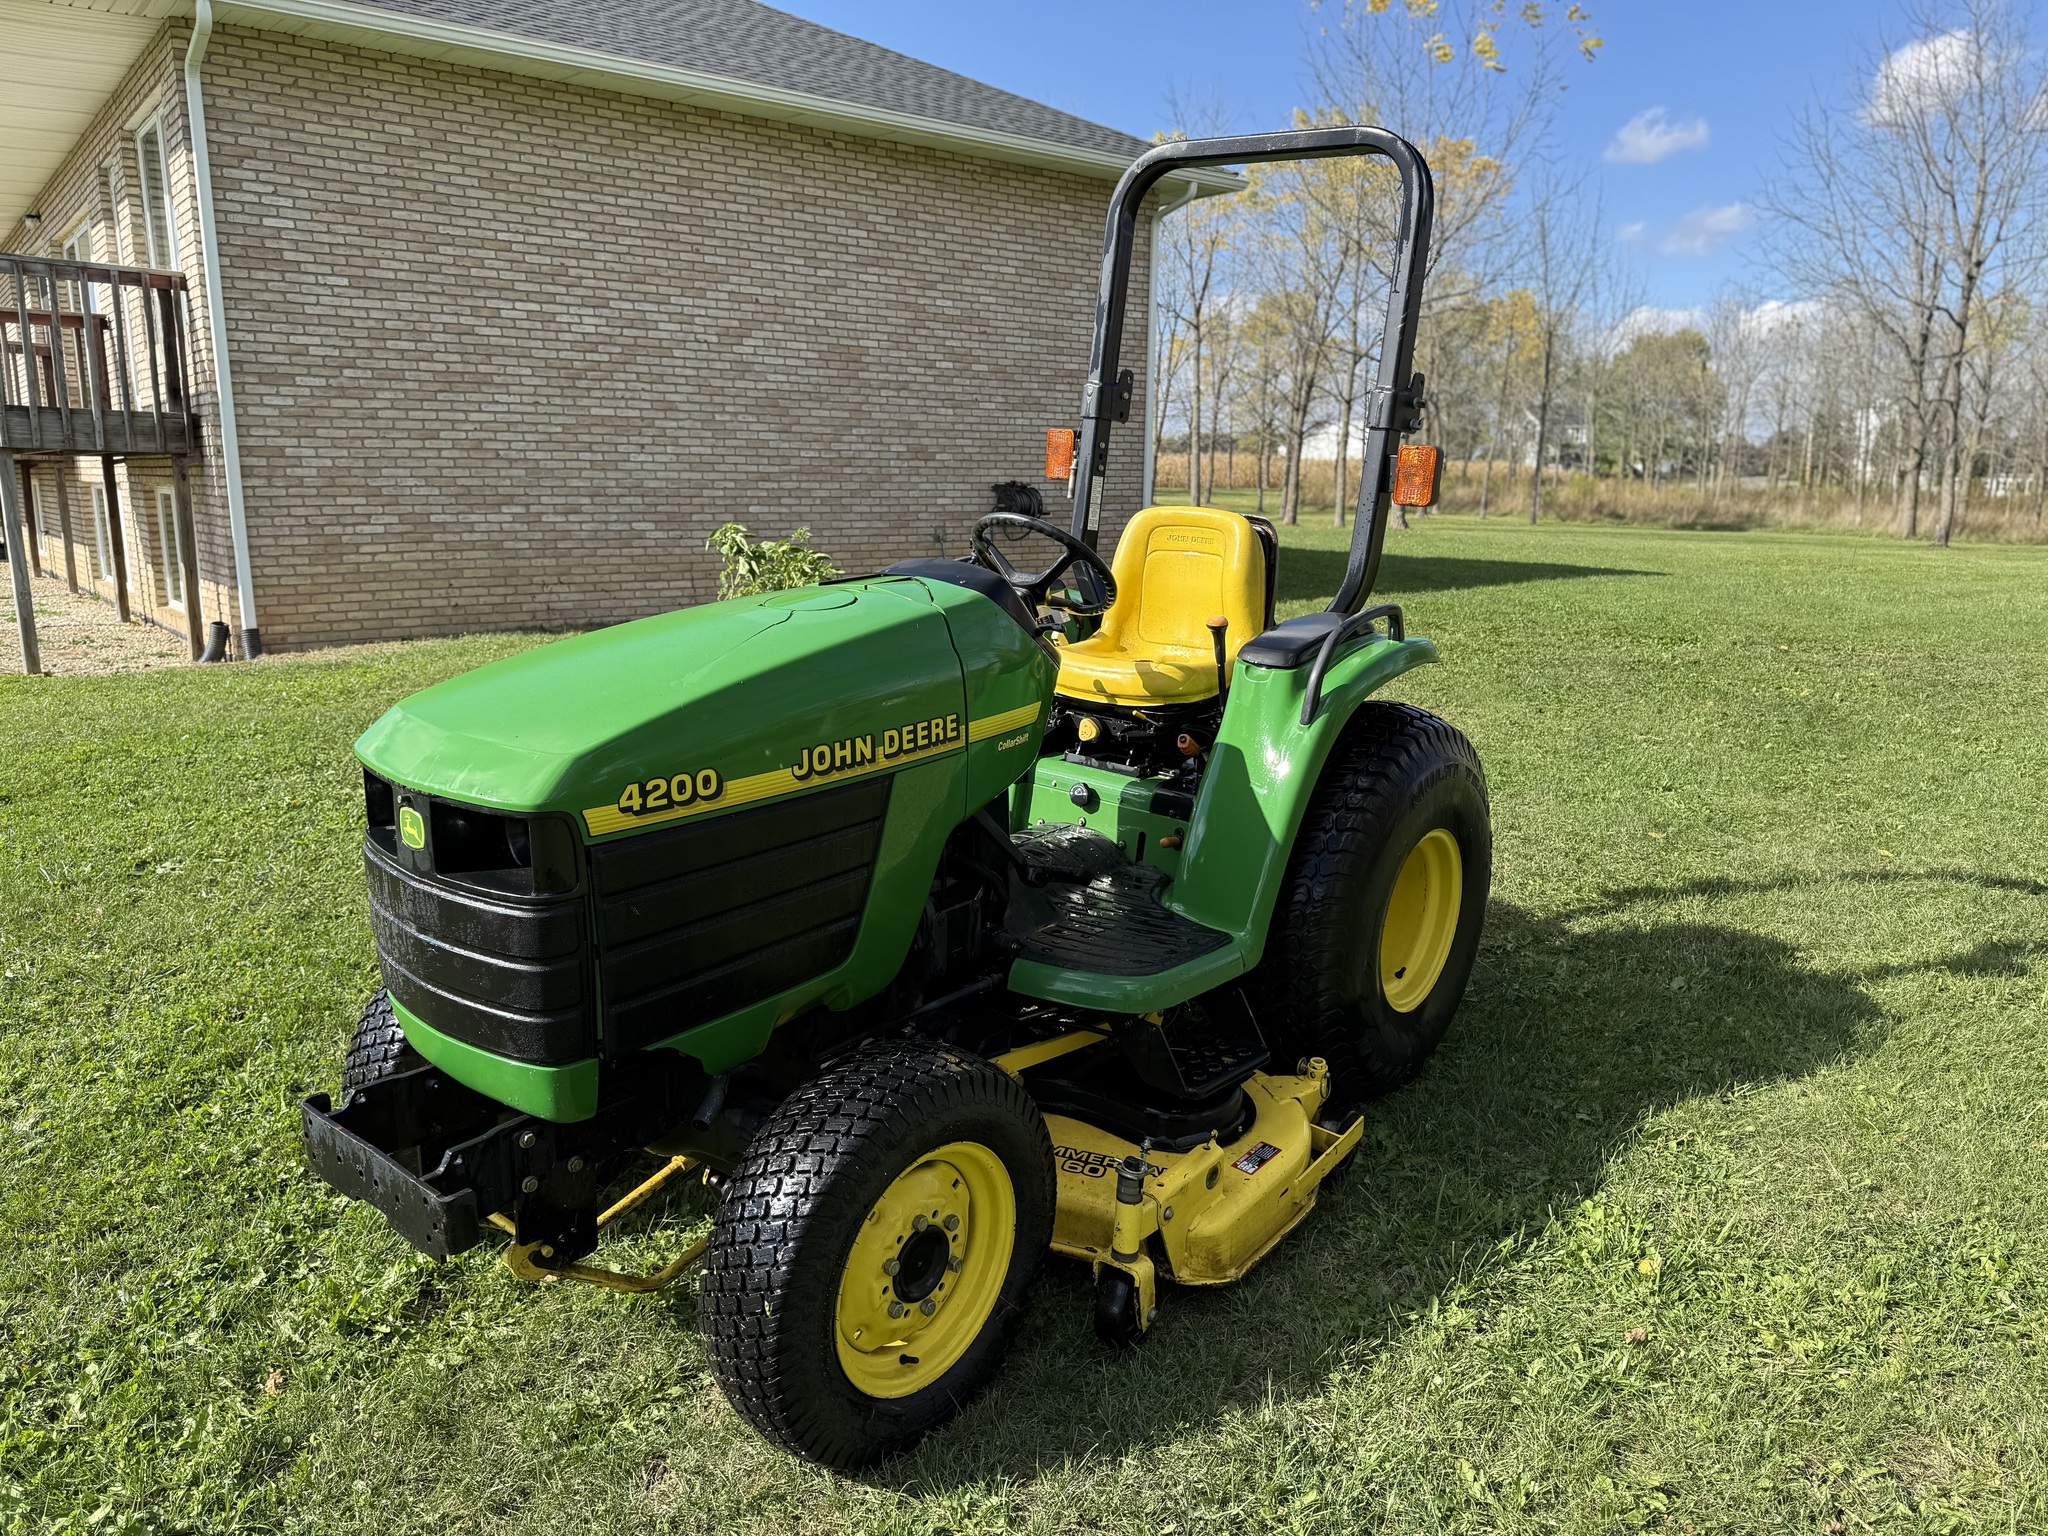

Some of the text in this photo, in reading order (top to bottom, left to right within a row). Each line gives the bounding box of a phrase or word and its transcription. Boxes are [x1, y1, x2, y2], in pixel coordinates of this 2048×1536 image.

[1166, 534, 1215, 545] JOHN DEERE
[792, 713, 960, 780] JOHN DEERE
[998, 733, 1029, 751] CollarShift
[618, 767, 724, 817] 4200
[1408, 762, 1459, 814] MULTI
[1061, 1159, 1107, 1178] 60
